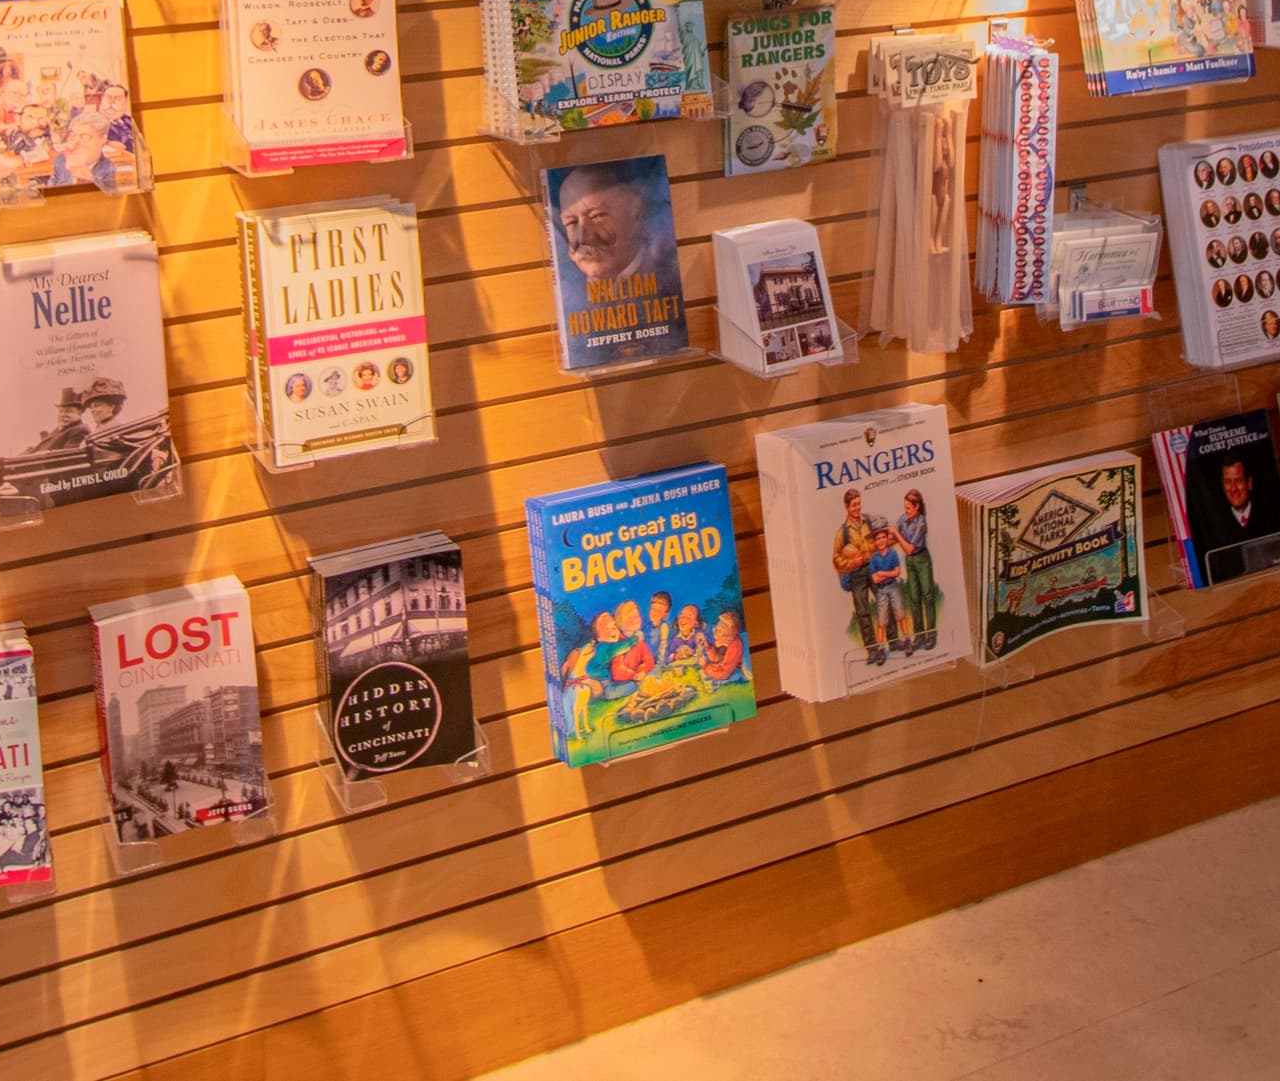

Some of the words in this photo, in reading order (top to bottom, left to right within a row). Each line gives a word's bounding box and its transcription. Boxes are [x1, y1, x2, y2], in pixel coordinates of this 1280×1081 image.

[560, 19, 606, 55] JUNIOR
[610, 8, 666, 30] RANGER
[732, 14, 792, 36] SONGS
[798, 11, 832, 25] FOR
[583, 48, 622, 65] NATIONAL
[624, 36, 647, 62] PARKS
[752, 30, 816, 52] JUNIOR
[741, 44, 825, 68] RANGERS
[588, 72, 642, 90] DISPLAY
[904, 54, 969, 88] TOYS
[558, 96, 598, 109] EXPLORE
[604, 92, 634, 102] LEARN
[640, 86, 681, 98] PROTECT
[1238, 140, 1274, 152] Presidents
[290, 223, 388, 273] FIRST
[281, 271, 404, 324] LADIES
[588, 272, 657, 304] WILLIAM
[32, 285, 112, 329] Nellie
[568, 303, 637, 336] HOWARD
[644, 295, 680, 320] TAFT
[586, 332, 632, 348] JEFFREY
[637, 325, 669, 339] ROSEN
[295, 403, 350, 422] SUSAN
[357, 392, 409, 410] SWAIN
[1209, 426, 1247, 442] SUPREME
[814, 440, 935, 491] RANGERS
[41, 481, 61, 494] Edited
[63, 480, 70, 490] by
[72, 475, 95, 488] LEWIS
[96, 473, 102, 482] L.
[103, 468, 128, 481] GOULD
[552, 510, 585, 525] LAURA
[588, 504, 613, 518] BUSH
[616, 502, 628, 510] AND
[630, 495, 661, 509] JENNA
[663, 487, 688, 500] BUSH
[691, 479, 720, 494] HAGER
[1033, 505, 1076, 524] AMERICA'S
[581, 531, 613, 551] Our
[618, 517, 666, 542] Great
[671, 512, 697, 530] Big
[1033, 518, 1076, 536] NATIONAL
[561, 527, 722, 592] BACKYARD
[1032, 547, 1074, 569] ACTIVITY
[1076, 535, 1109, 554] BOOK
[117, 611, 239, 669] LOST
[119, 649, 241, 689] CINCINNATI
[348, 680, 428, 706] HIDDEN
[340, 698, 431, 727] HISTORY
[383, 721, 392, 731] of
[348, 728, 430, 753] CINCINNATI
